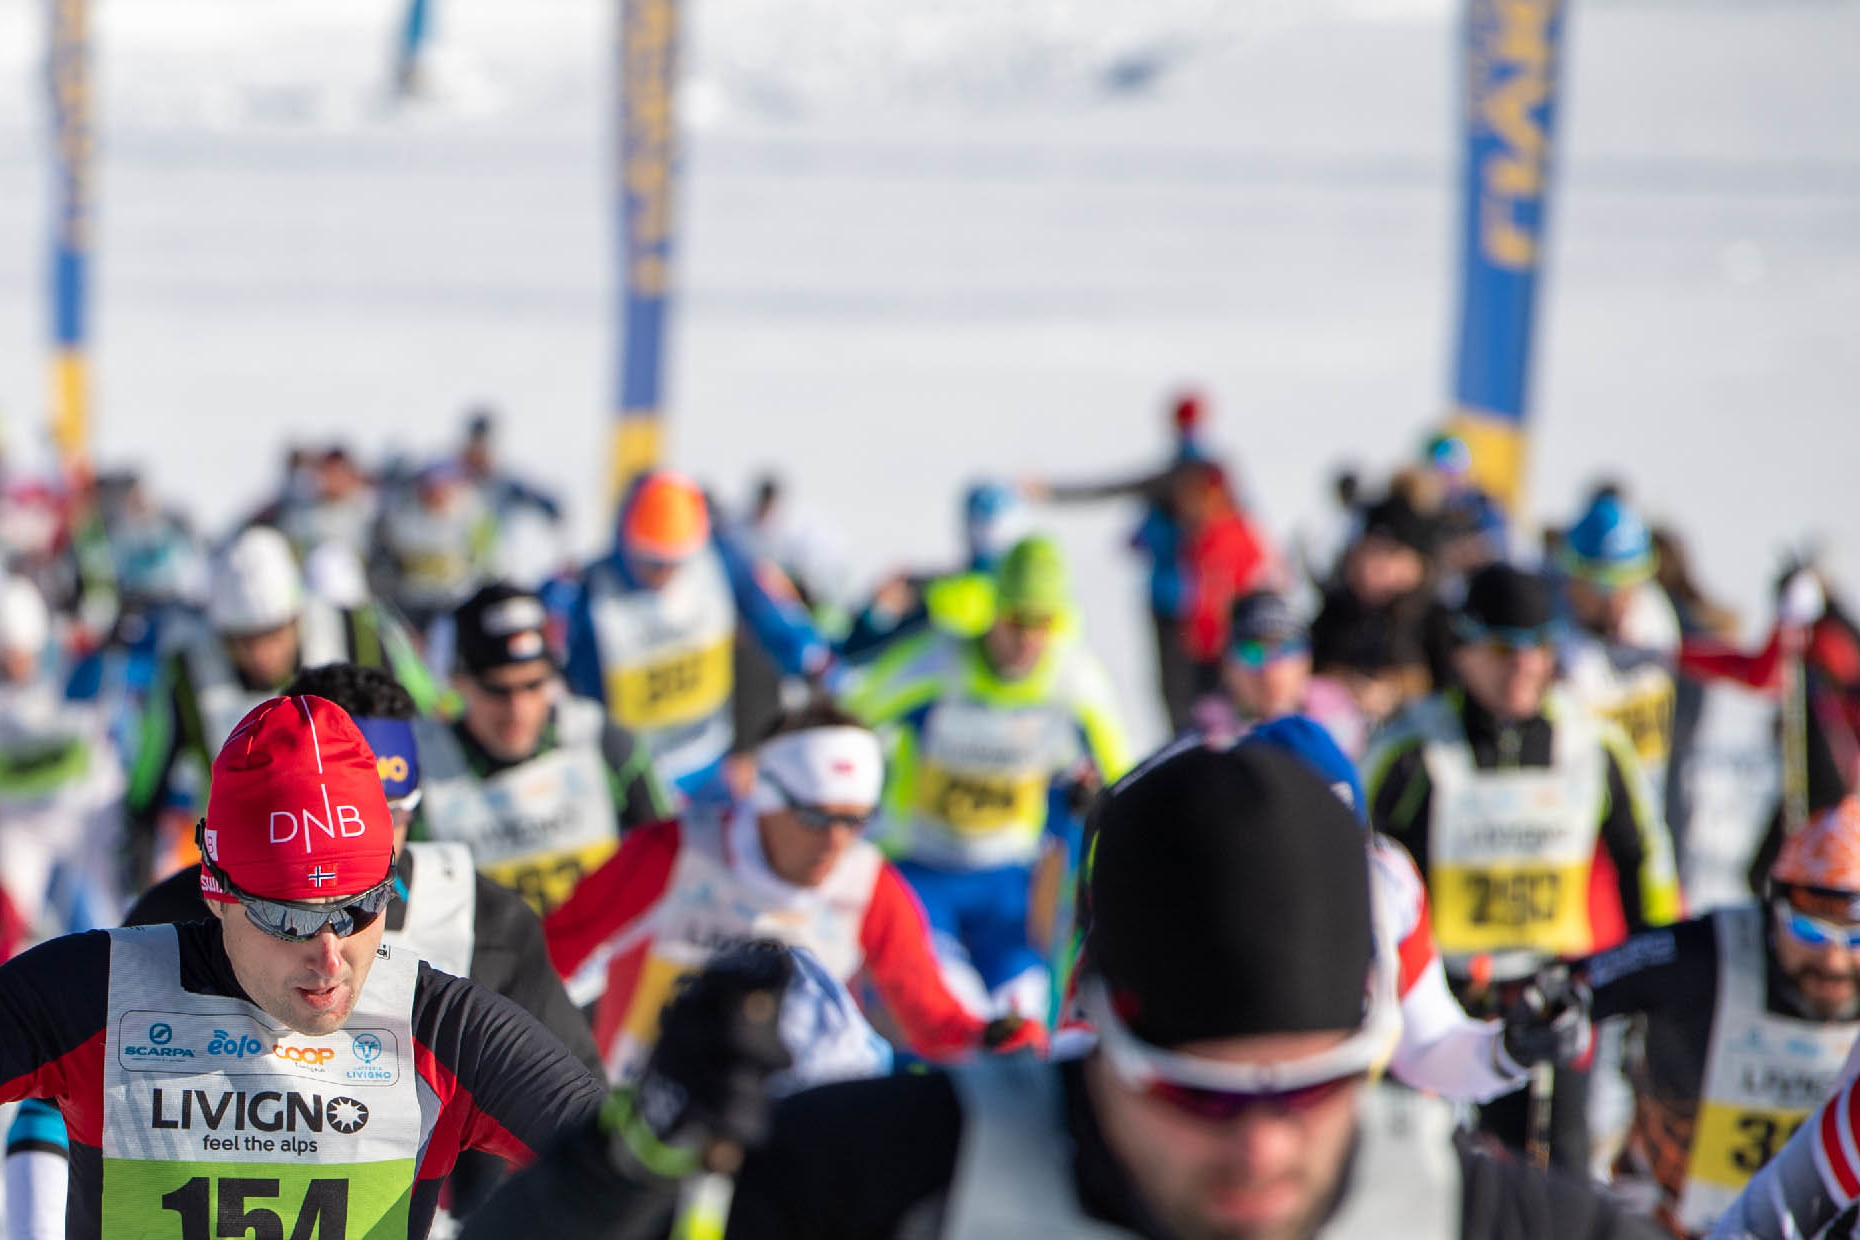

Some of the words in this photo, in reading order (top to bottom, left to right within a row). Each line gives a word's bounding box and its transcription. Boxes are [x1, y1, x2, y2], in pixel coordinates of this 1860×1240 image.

[269, 783, 366, 853] DNB
[201, 874, 224, 894] swi
[124, 1045, 196, 1058] SCARPA
[207, 1030, 261, 1058] eolo
[345, 1071, 392, 1080] LIVIGNO
[151, 1088, 370, 1135] LIVIGNO
[202, 1134, 240, 1151] feel
[244, 1136, 275, 1152] the
[280, 1136, 318, 1157] alps
